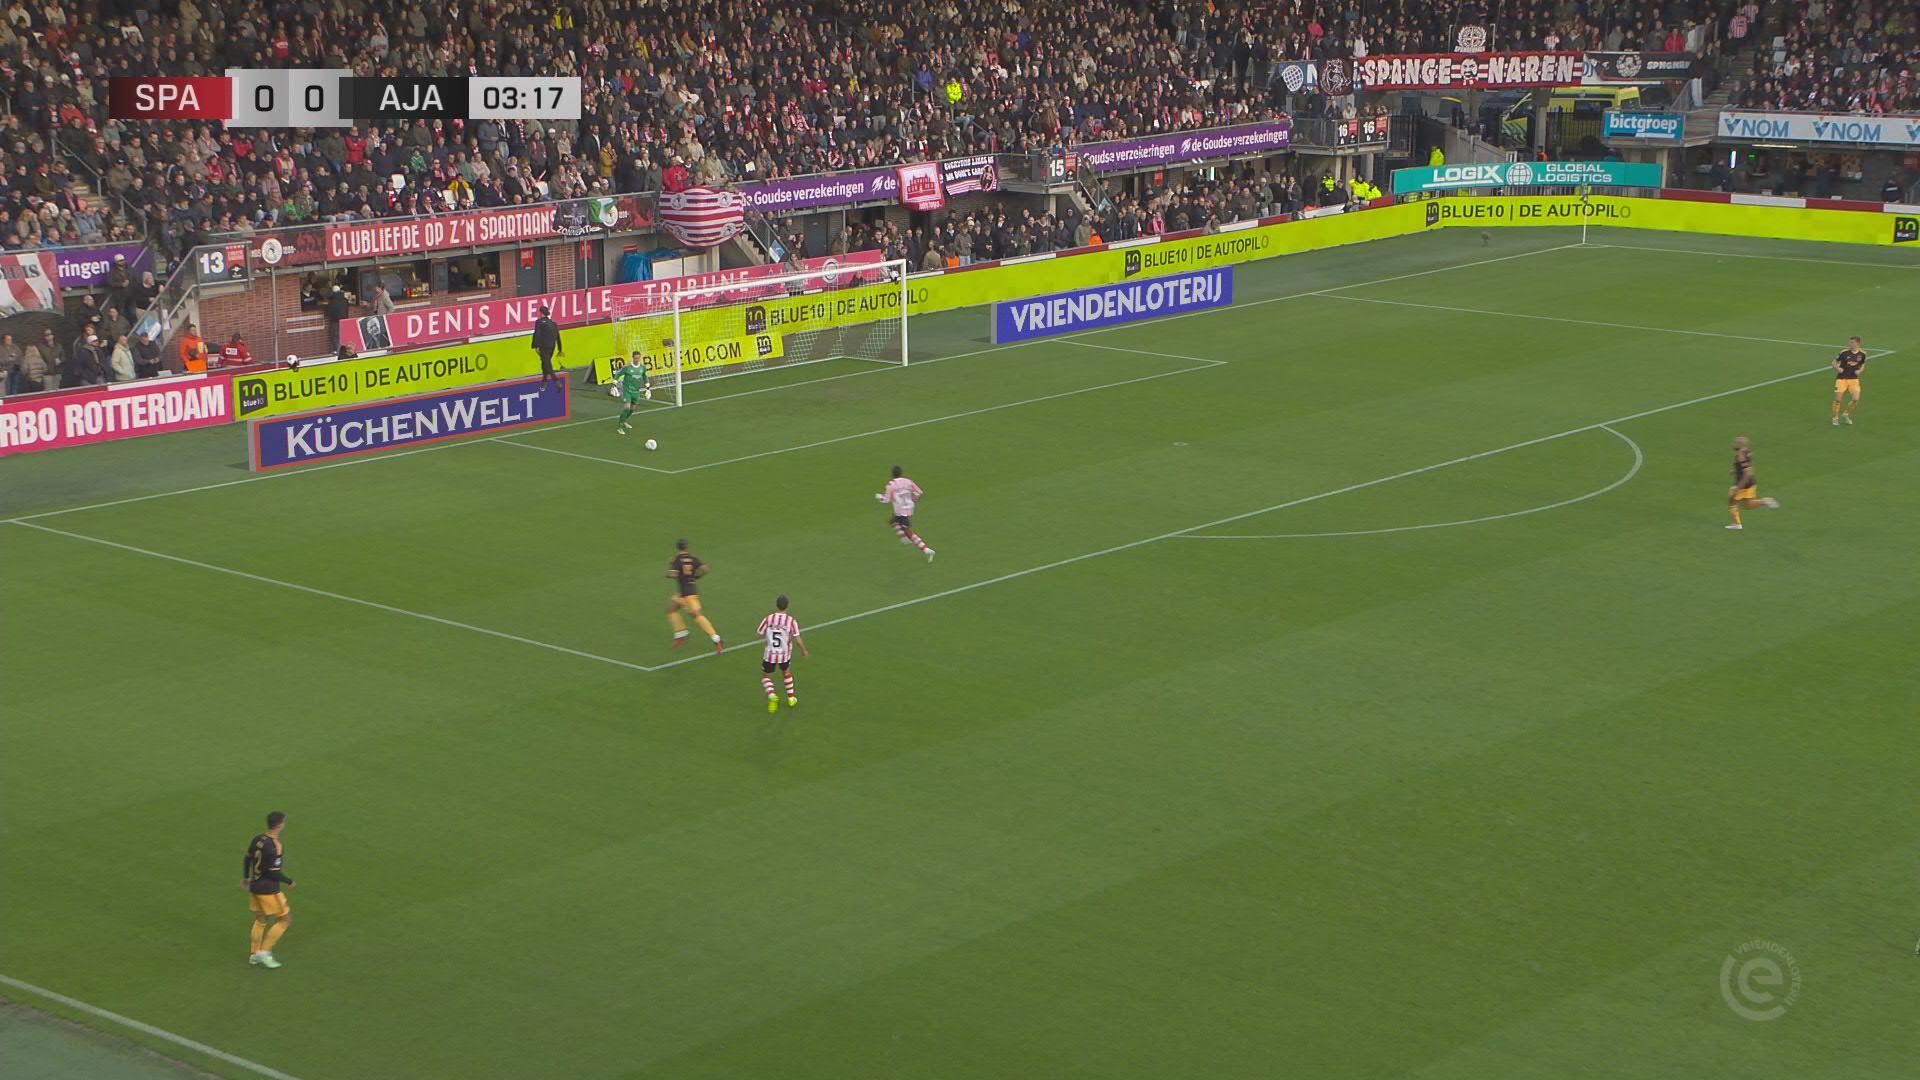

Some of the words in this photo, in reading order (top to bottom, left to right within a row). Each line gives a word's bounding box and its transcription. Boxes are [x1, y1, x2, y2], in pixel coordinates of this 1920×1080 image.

[1488, 56, 1574, 83] NAREN
[1339, 123, 1348, 137] 16
[1363, 121, 1375, 134] 16
[1609, 112, 1677, 133] bictgroep
[1191, 138, 1201, 151] de
[1203, 135, 1232, 150] Goudse
[1232, 129, 1288, 147] verzekeringen
[1116, 144, 1175, 161] verzekeringen
[1050, 160, 1065, 177] 15
[1433, 165, 1503, 183] LOGIX
[1537, 173, 1612, 183] LOGISTICS
[1546, 163, 1605, 172] GLOBAL
[754, 188, 792, 205] Goudse
[793, 183, 864, 201] verzekeringen
[884, 177, 896, 190] de
[1441, 204, 1504, 219] BLUE10
[1520, 204, 1541, 218] DE
[1547, 203, 1631, 219] AUTOPILO
[332, 224, 419, 257] CLUBLIEFDE
[425, 222, 444, 247] OP
[450, 217, 475, 244] Z'N
[1145, 249, 1187, 268] BLUE10
[1197, 244, 1212, 260] DE
[1215, 234, 1269, 257] AUTOPILO
[58, 260, 110, 280] ringen
[200, 251, 225, 275] 13
[1010, 272, 1222, 332] VRIENDENLOTERIJ
[407, 305, 490, 339] DENIS
[506, 289, 611, 326] NEVILLE
[770, 303, 825, 327] BLUE10
[837, 299, 856, 316] DE
[274, 372, 349, 402] BLUE10
[365, 365, 391, 389] DE
[396, 353, 488, 384] AUTOPILO
[0, 407, 58, 449] RBO
[64, 384, 226, 439] ROTTERDAM
[772, 631, 782, 648] 5
